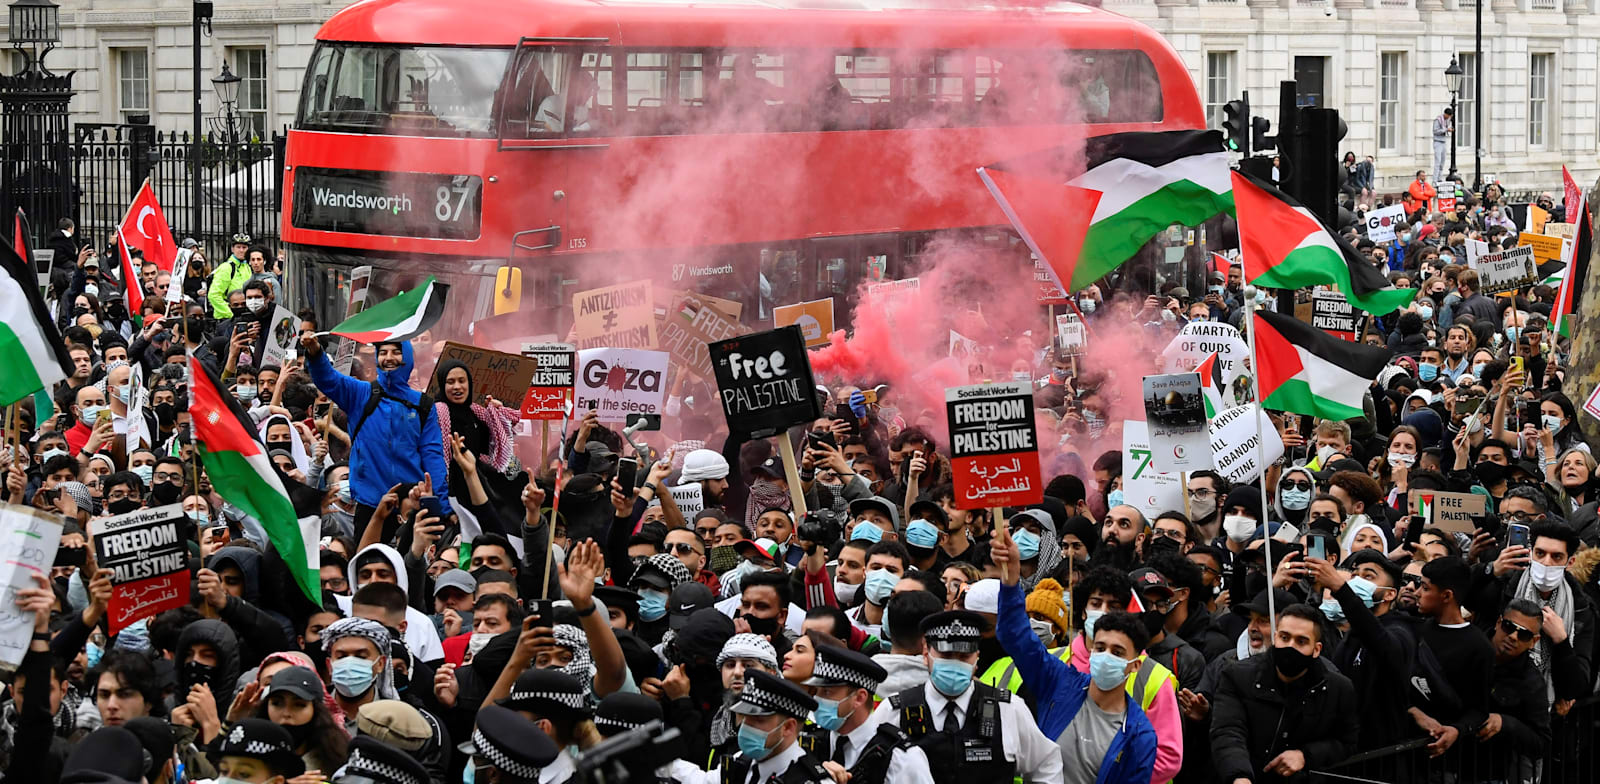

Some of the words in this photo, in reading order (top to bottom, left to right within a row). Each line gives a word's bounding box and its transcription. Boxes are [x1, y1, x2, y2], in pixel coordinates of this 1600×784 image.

[312, 187, 412, 212] Wandsworth
[435, 186, 471, 222] 87
[569, 239, 587, 249] LT55
[1477, 247, 1532, 265] #StopArming
[672, 264, 686, 281] 87
[688, 263, 733, 278] Wandsworth
[1494, 259, 1519, 272] Israel
[580, 285, 647, 317] ANTIZIONISM
[1315, 300, 1353, 314] FREEDOM
[1312, 316, 1354, 331] PALESTINE
[1181, 341, 1196, 352] OF
[1199, 342, 1232, 354] QUDS
[487, 355, 520, 373] WAR
[526, 353, 570, 367] EEDOM
[530, 372, 572, 386] ALESTINE
[1151, 381, 1168, 389] Save
[722, 377, 806, 415] PALESTINE
[957, 387, 991, 399] Socialist
[991, 386, 1020, 396] Worker
[602, 397, 619, 411] the
[620, 399, 656, 416] siege
[954, 399, 1026, 425] FREEDOM
[985, 421, 998, 431] for
[953, 428, 1033, 454] PALESTINE
[969, 458, 1022, 479] الحرية
[965, 476, 1032, 500] لفلسطين
[1440, 497, 1463, 508] FREE
[104, 514, 139, 530] Socialist
[139, 510, 169, 522] Worker
[101, 522, 178, 558] FREEDOM
[136, 550, 150, 561] for
[119, 578, 171, 599] الحرية
[117, 587, 178, 623] لفلسطين
